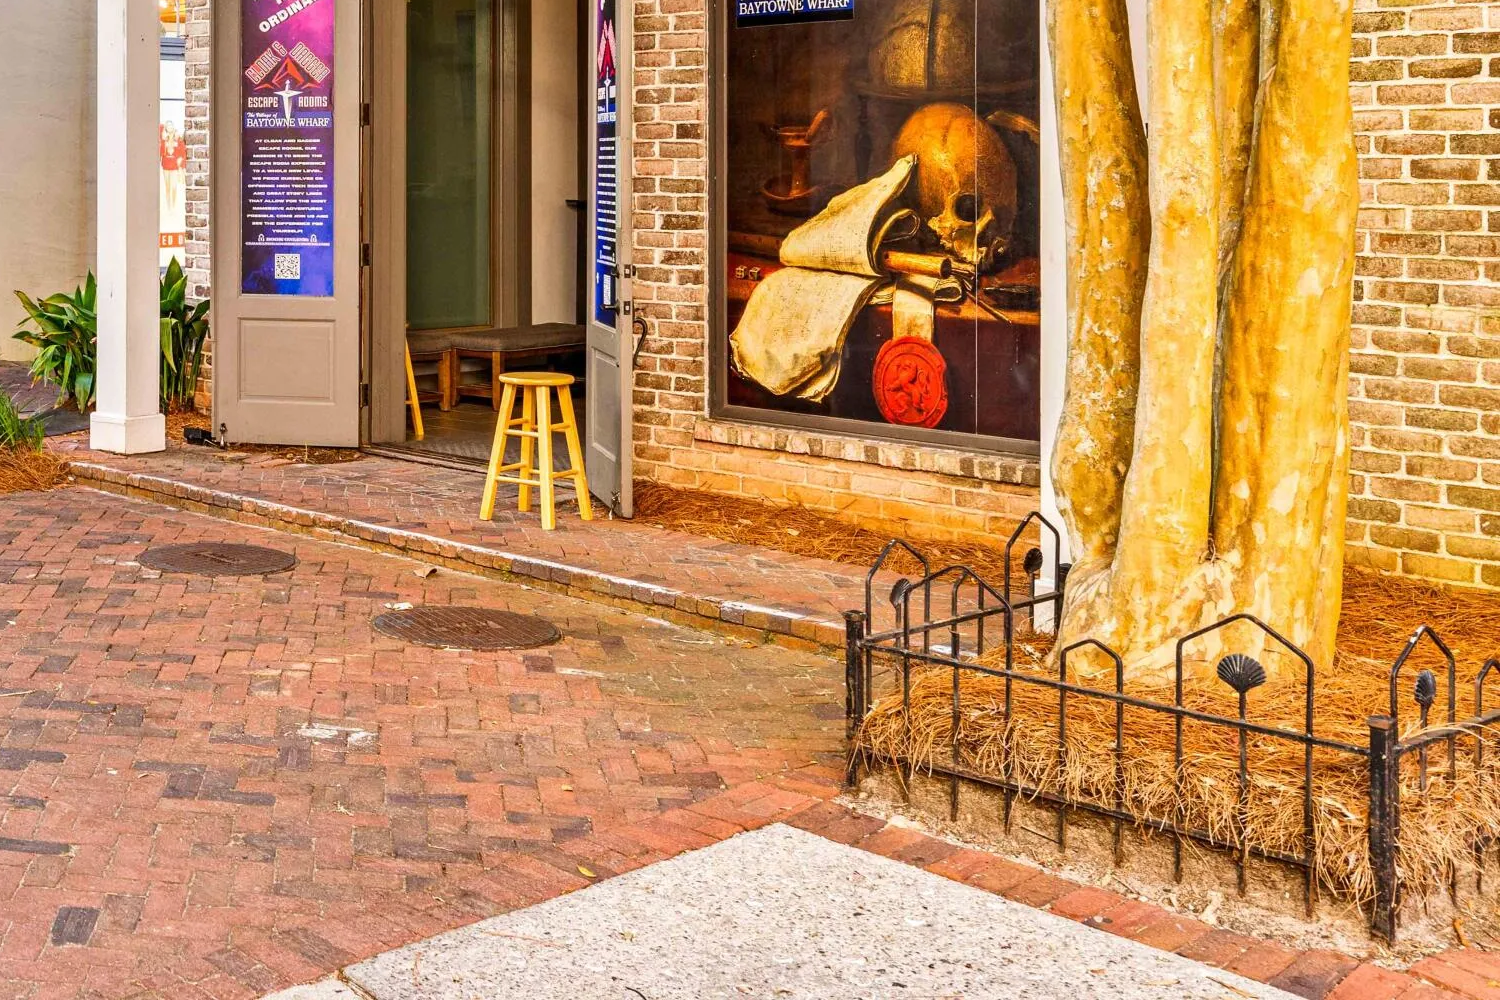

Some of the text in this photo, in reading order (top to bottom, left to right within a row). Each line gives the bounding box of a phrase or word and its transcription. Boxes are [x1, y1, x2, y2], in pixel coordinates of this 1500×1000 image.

[245, 48, 281, 85] CLOAK
[288, 42, 331, 83] DAGGER
[247, 96, 327, 108] ESCAPE ROOMS
[272, 111, 278, 119] of
[246, 117, 330, 128] BAYTOWNE WHARF
